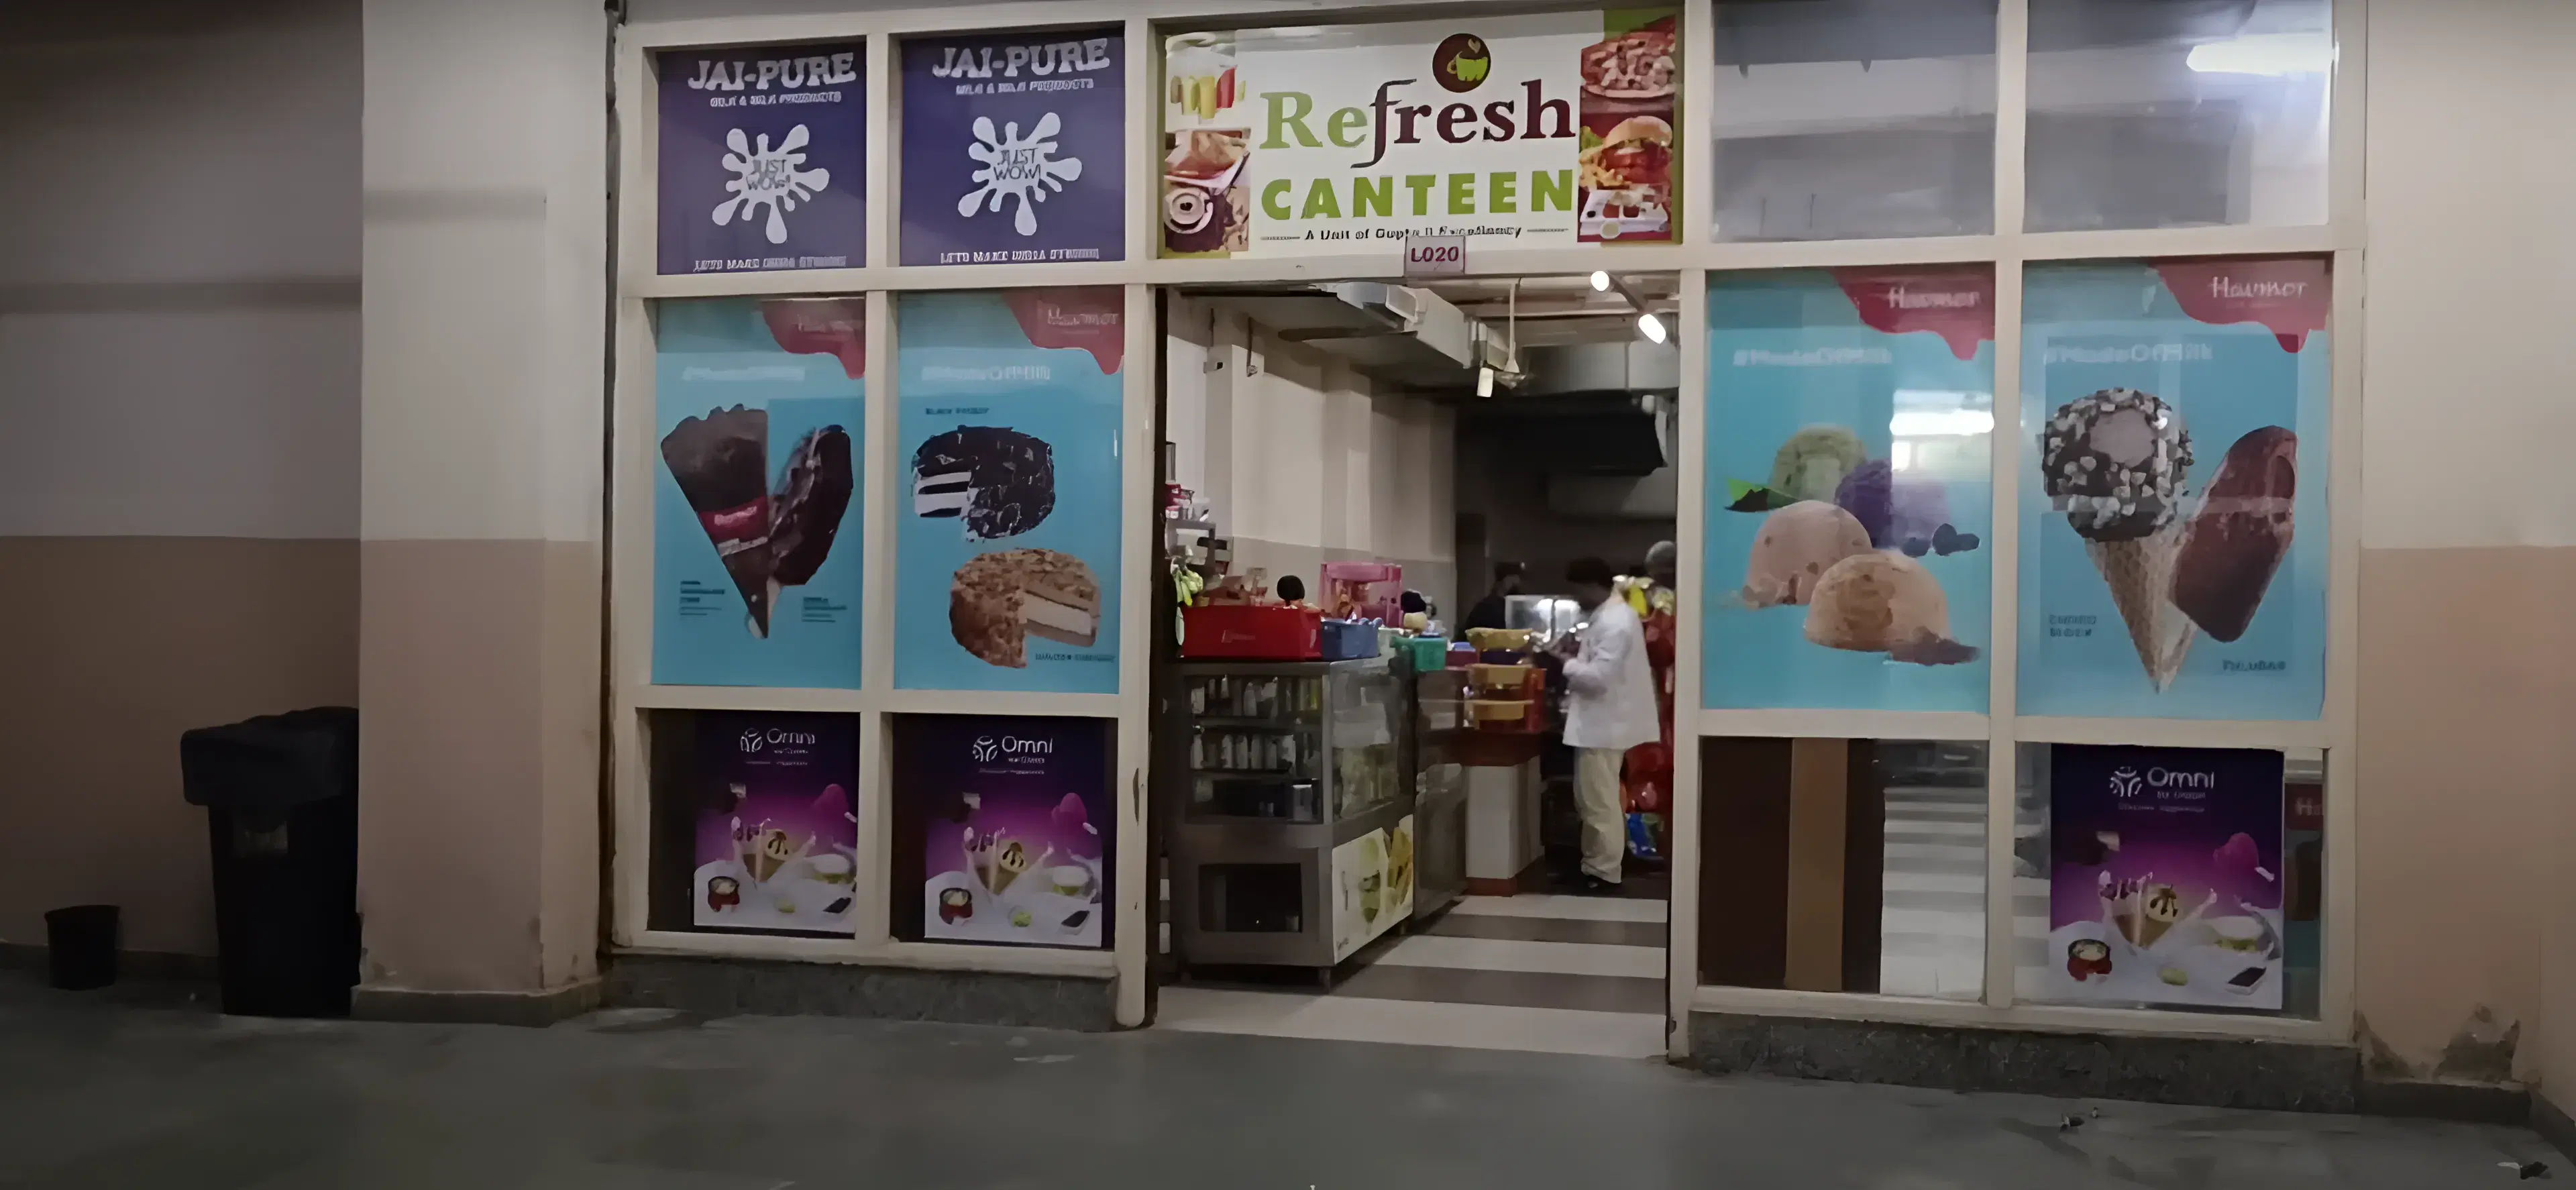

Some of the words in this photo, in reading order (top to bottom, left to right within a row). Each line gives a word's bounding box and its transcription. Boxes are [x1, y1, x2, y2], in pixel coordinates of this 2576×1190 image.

[688, 52, 857, 91] JAI-PURE
[932, 38, 1110, 78] JAI-PURE
[1258, 78, 1576, 169] Refresh
[1261, 169, 1573, 220] CANTEEN
[1002, 735, 1053, 753] Omni
[2147, 767, 2214, 789] Omni
